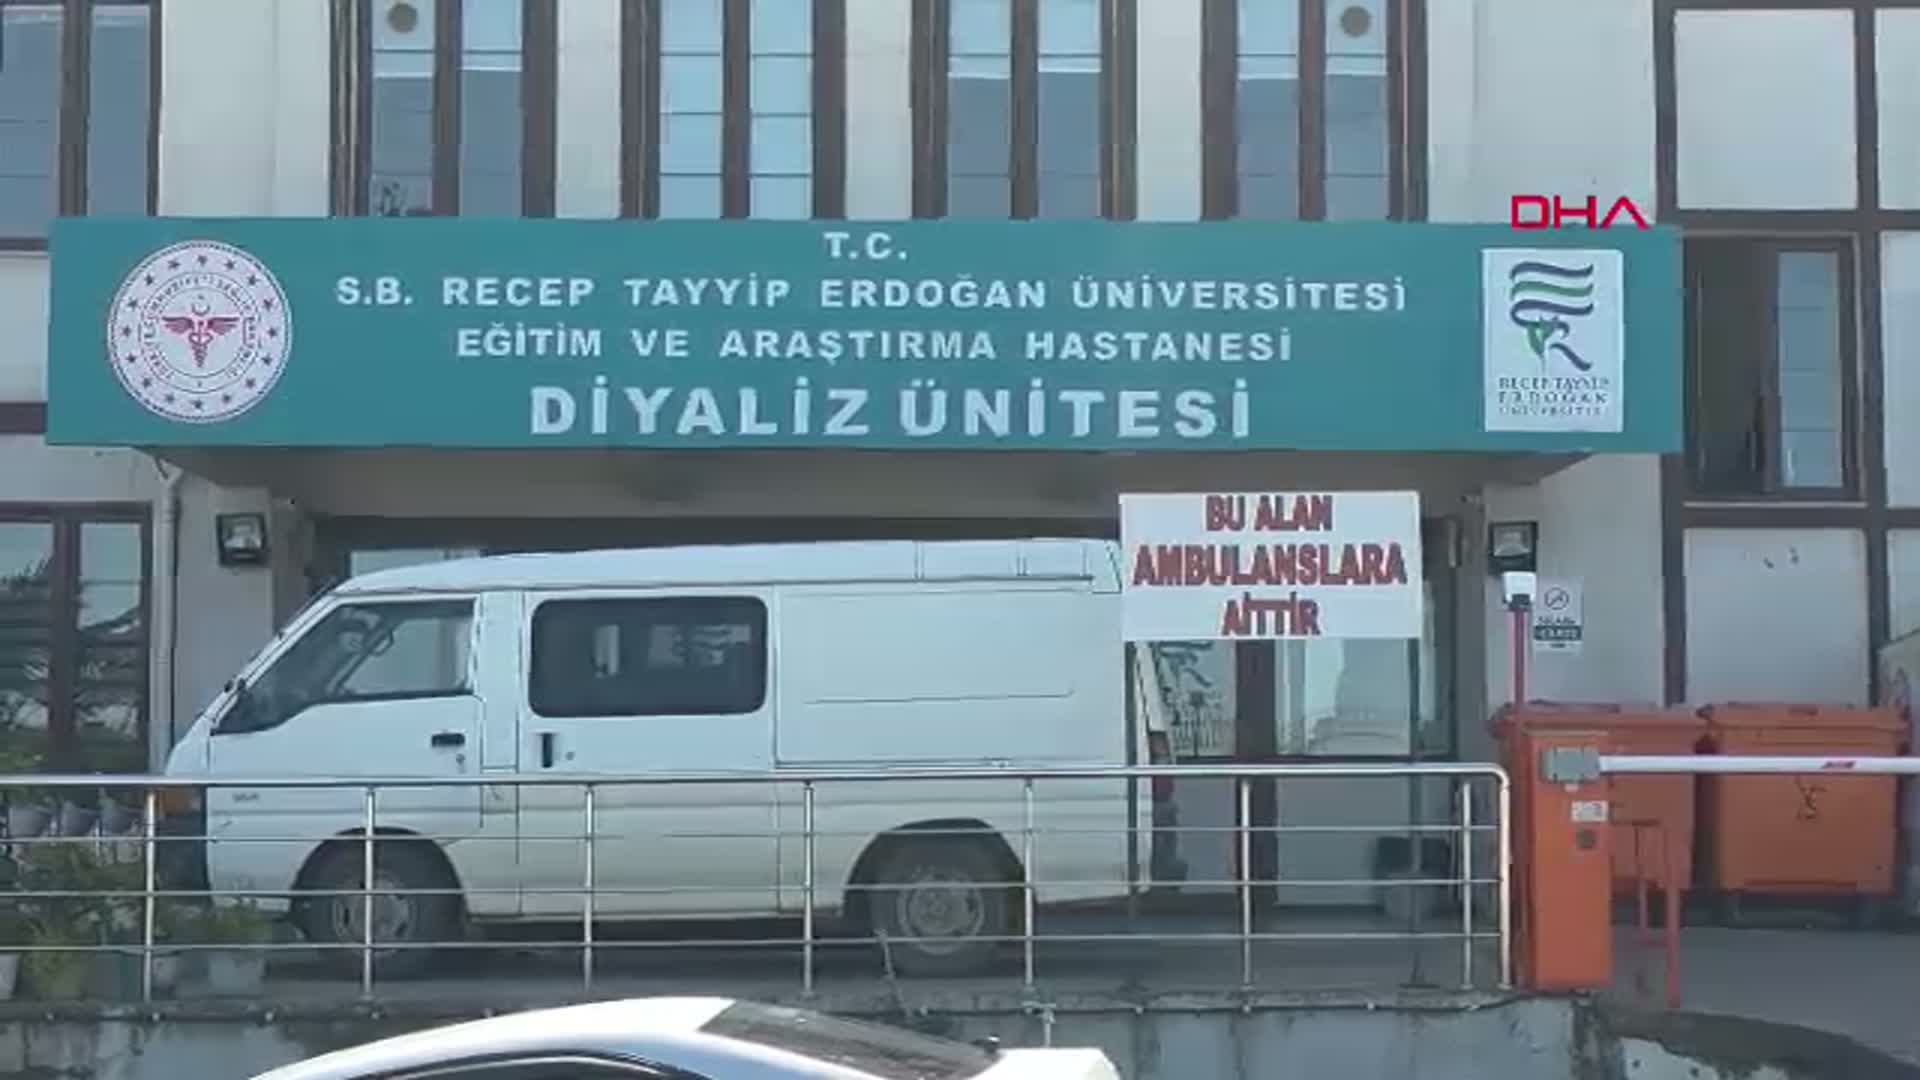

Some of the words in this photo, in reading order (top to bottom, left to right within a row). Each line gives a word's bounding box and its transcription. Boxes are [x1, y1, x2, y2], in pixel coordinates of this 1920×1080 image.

[822, 231, 907, 260] T.C.
[336, 276, 413, 305] S.B.
[442, 277, 594, 307] RECEP
[623, 272, 790, 307] TAYYİP
[820, 274, 1046, 308] ERDOĞAN
[1072, 274, 1407, 311] ÜNİVERSİTESİ
[456, 322, 601, 357] EĞİTİM
[631, 329, 690, 357] VE
[718, 329, 996, 364] ARAŞTIRMA
[1025, 327, 1292, 361] HASTANESİ
[529, 375, 870, 435] DİYALİZ
[900, 378, 1250, 438] ÜNİTESİ
[1205, 494, 1247, 532] BU
[1254, 494, 1334, 532] ALAN
[1132, 542, 1409, 587] AMBULANSLARA
[1221, 591, 1322, 636] AİTTİR
